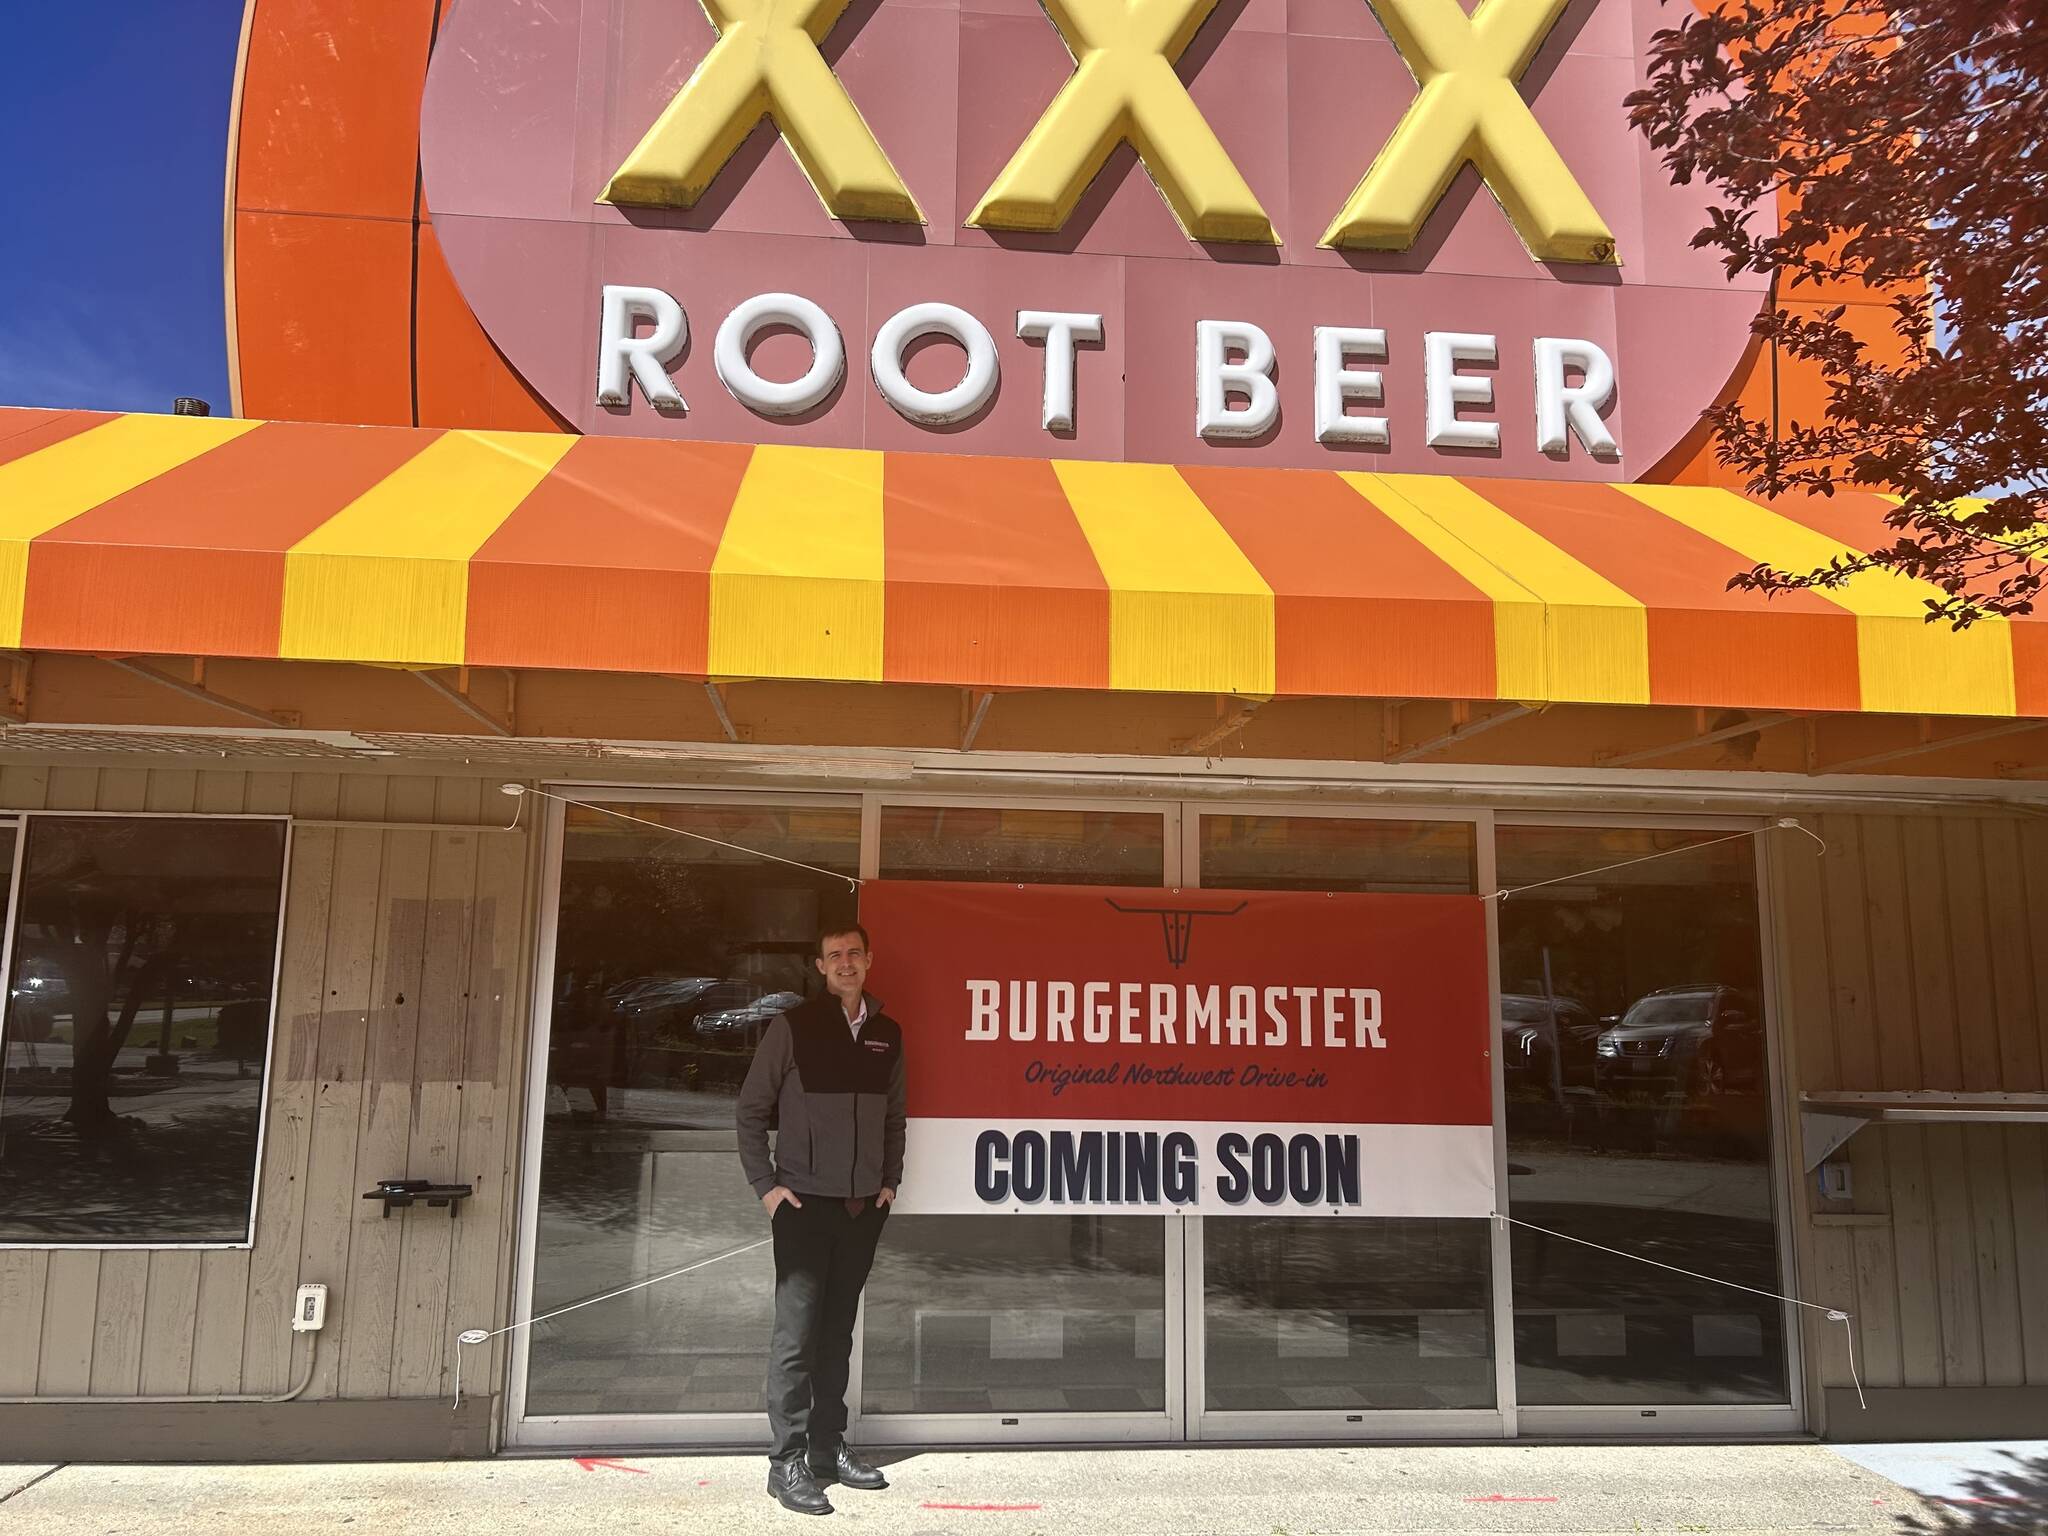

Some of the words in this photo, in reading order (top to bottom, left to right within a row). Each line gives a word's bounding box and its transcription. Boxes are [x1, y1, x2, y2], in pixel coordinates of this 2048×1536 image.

[595, 0, 1623, 267] XXX
[596, 285, 1104, 432] ROOT
[1196, 320, 1623, 457] BEER
[965, 979, 1387, 1048] BURGERMASTER
[1024, 1060, 1120, 1096] Original
[1122, 1062, 1236, 1087] Northwest
[1239, 1064, 1329, 1088] Drive-in
[974, 1129, 1199, 1206] COMING
[1216, 1132, 1362, 1207] SOON
